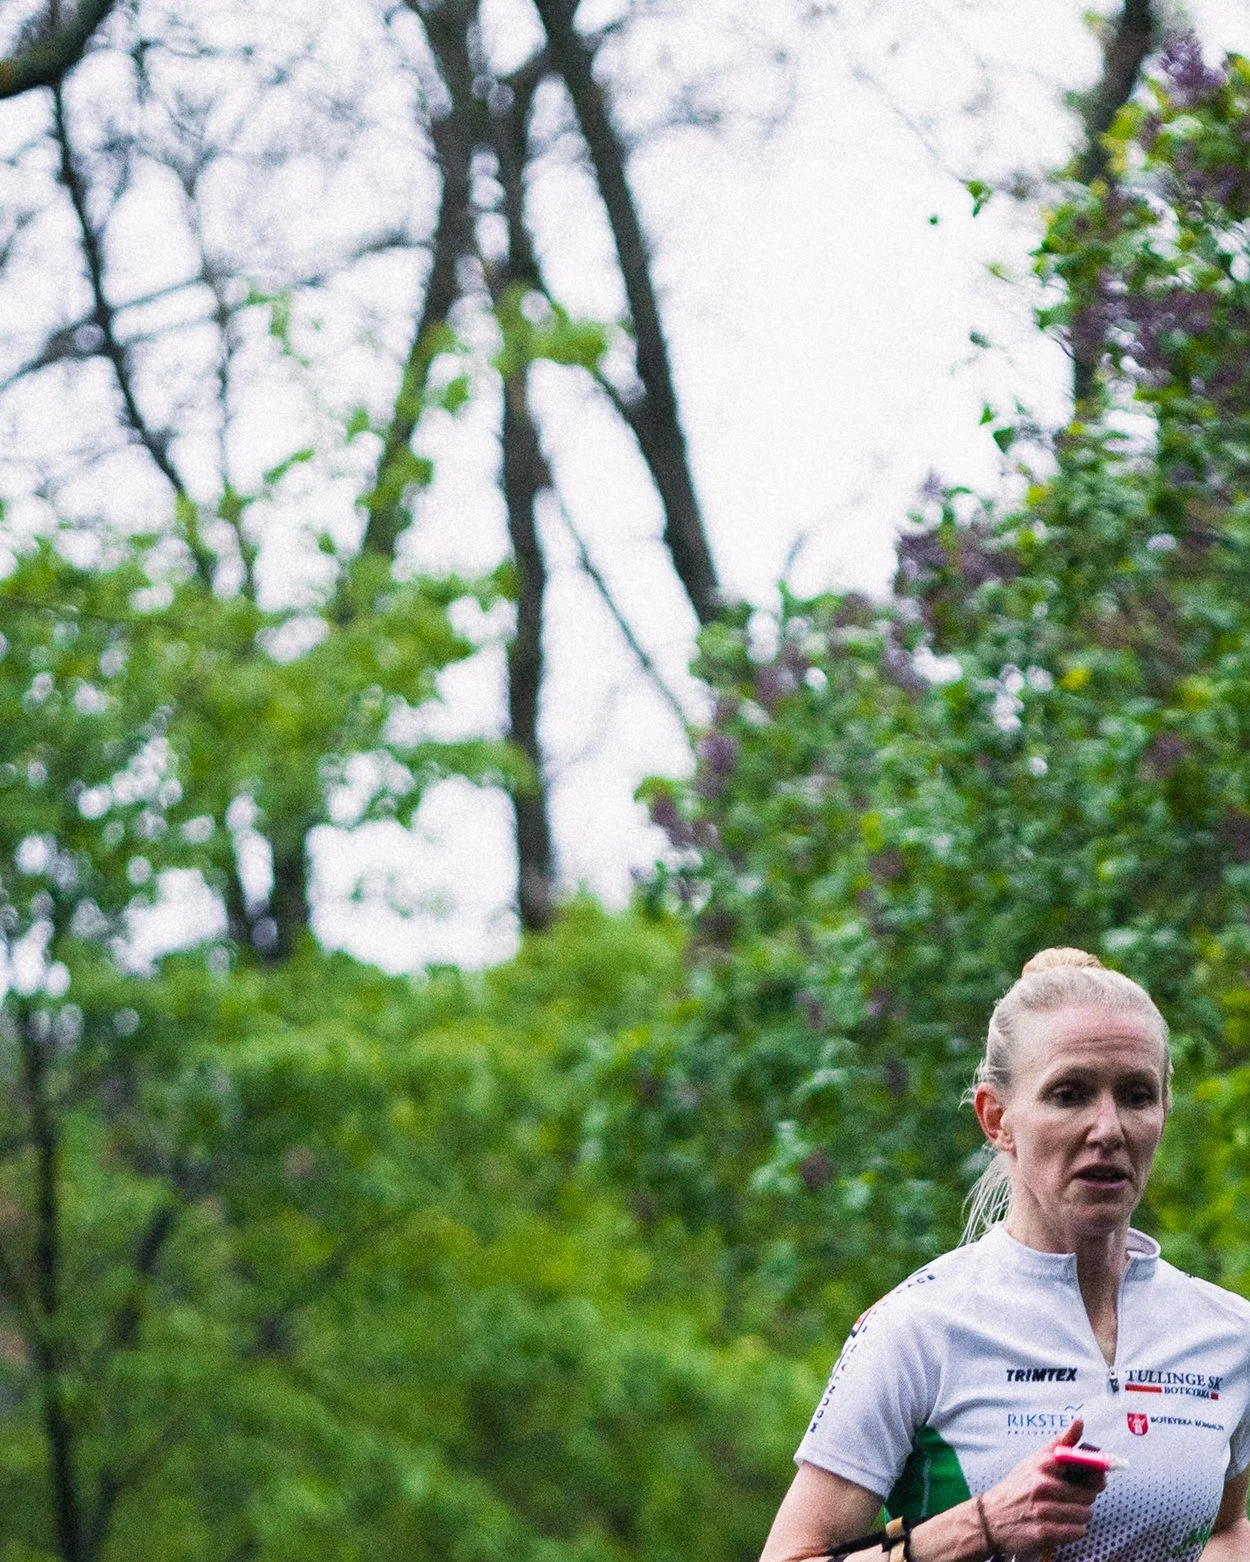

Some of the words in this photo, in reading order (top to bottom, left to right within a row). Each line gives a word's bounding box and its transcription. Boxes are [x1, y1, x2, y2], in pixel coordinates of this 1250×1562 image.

[1006, 1367, 1078, 1382] TRIMTEX
[1125, 1369, 1206, 1387] TULLINGE
[1207, 1375, 1223, 1391] SK
